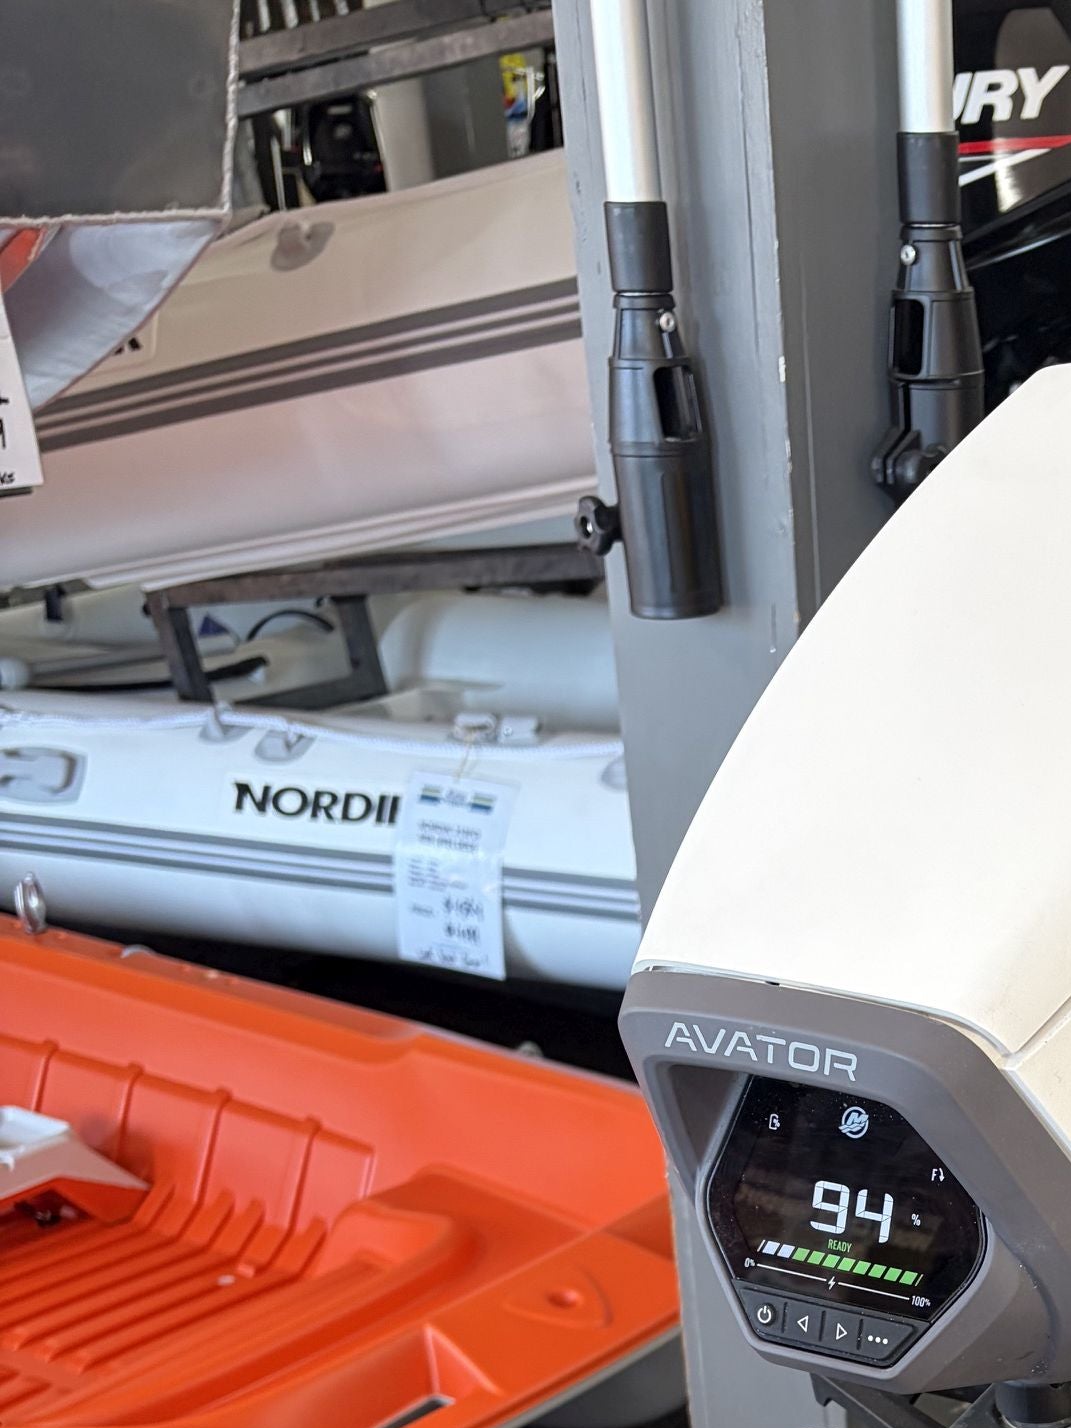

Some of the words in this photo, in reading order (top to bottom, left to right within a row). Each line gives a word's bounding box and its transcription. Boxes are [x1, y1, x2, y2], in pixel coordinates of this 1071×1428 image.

[234, 782, 400, 825] NORDI
[664, 1021, 858, 1082] AVATOR
[810, 1180, 894, 1244] 94
[827, 1238, 853, 1254] READY
[743, 1256, 756, 1269] 0%
[911, 1295, 932, 1308] 100%
